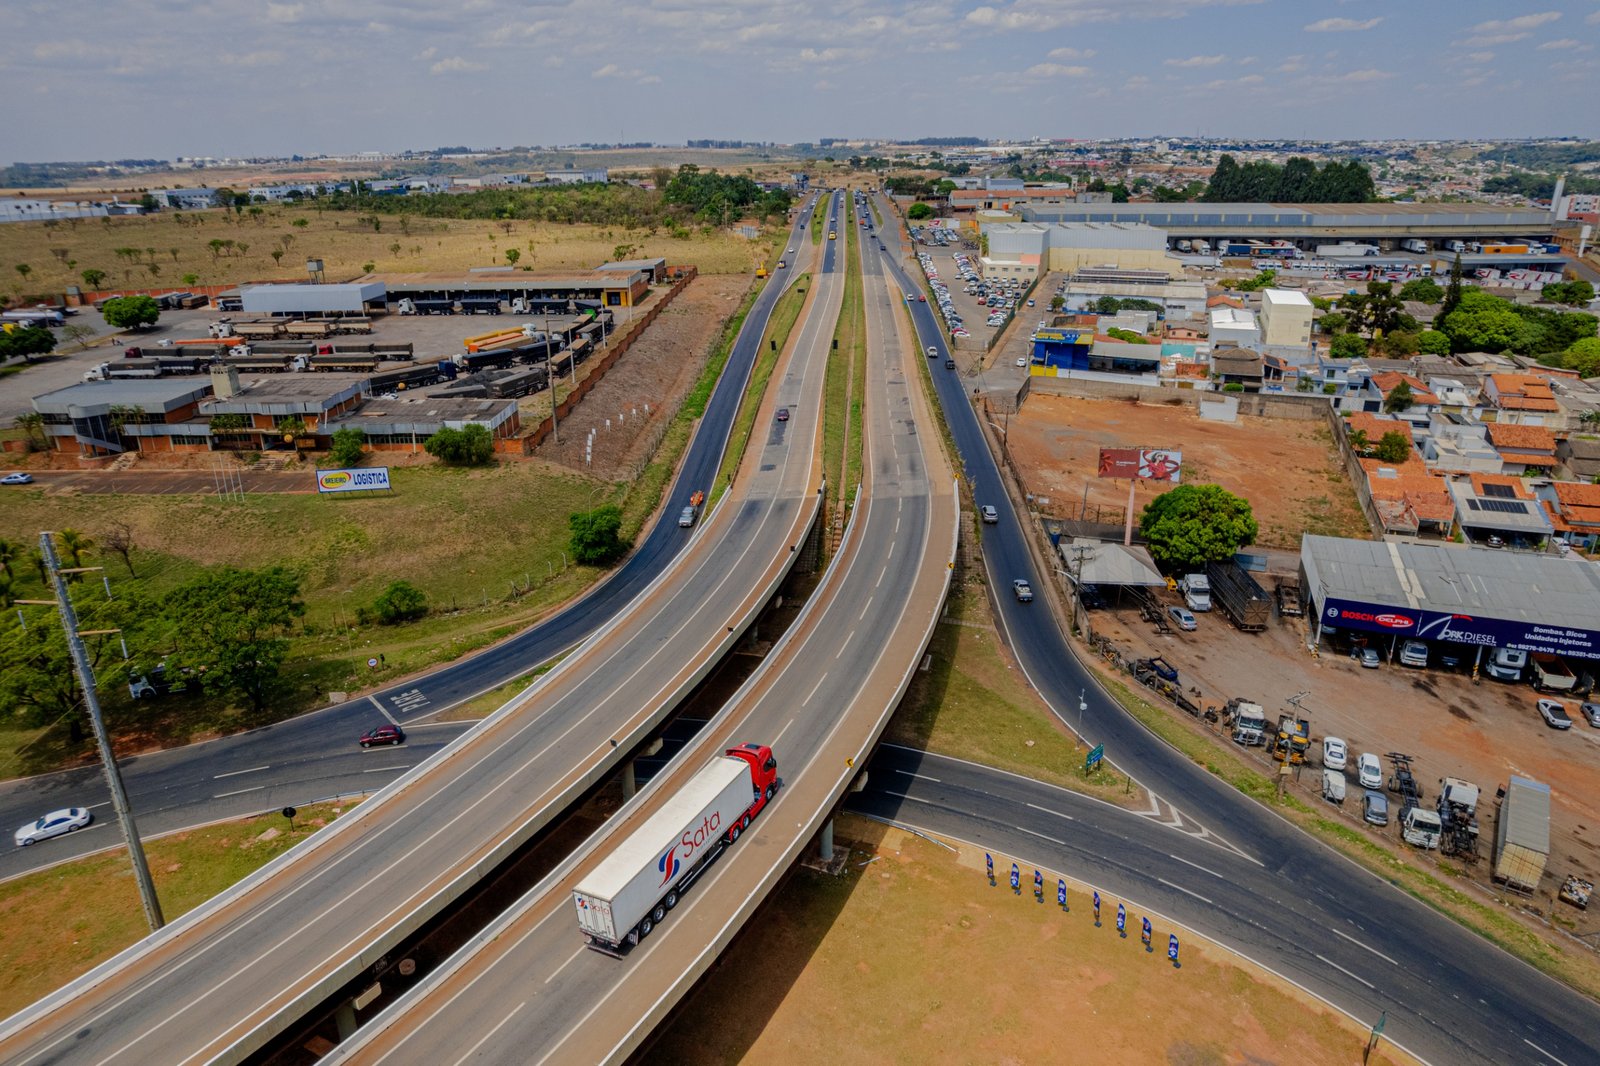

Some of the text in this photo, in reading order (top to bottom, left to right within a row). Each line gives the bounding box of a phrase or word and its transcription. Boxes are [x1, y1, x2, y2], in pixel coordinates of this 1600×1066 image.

[353, 472, 387, 485] LOGÍSTICA
[1342, 611, 1373, 621] BOSCH
[1379, 617, 1409, 625] DELPHI
[1524, 633, 1592, 647] Unidades Injetoras
[1566, 630, 1587, 638] Bicos
[390, 689, 431, 712] PARE
[681, 811, 721, 858] Sata
